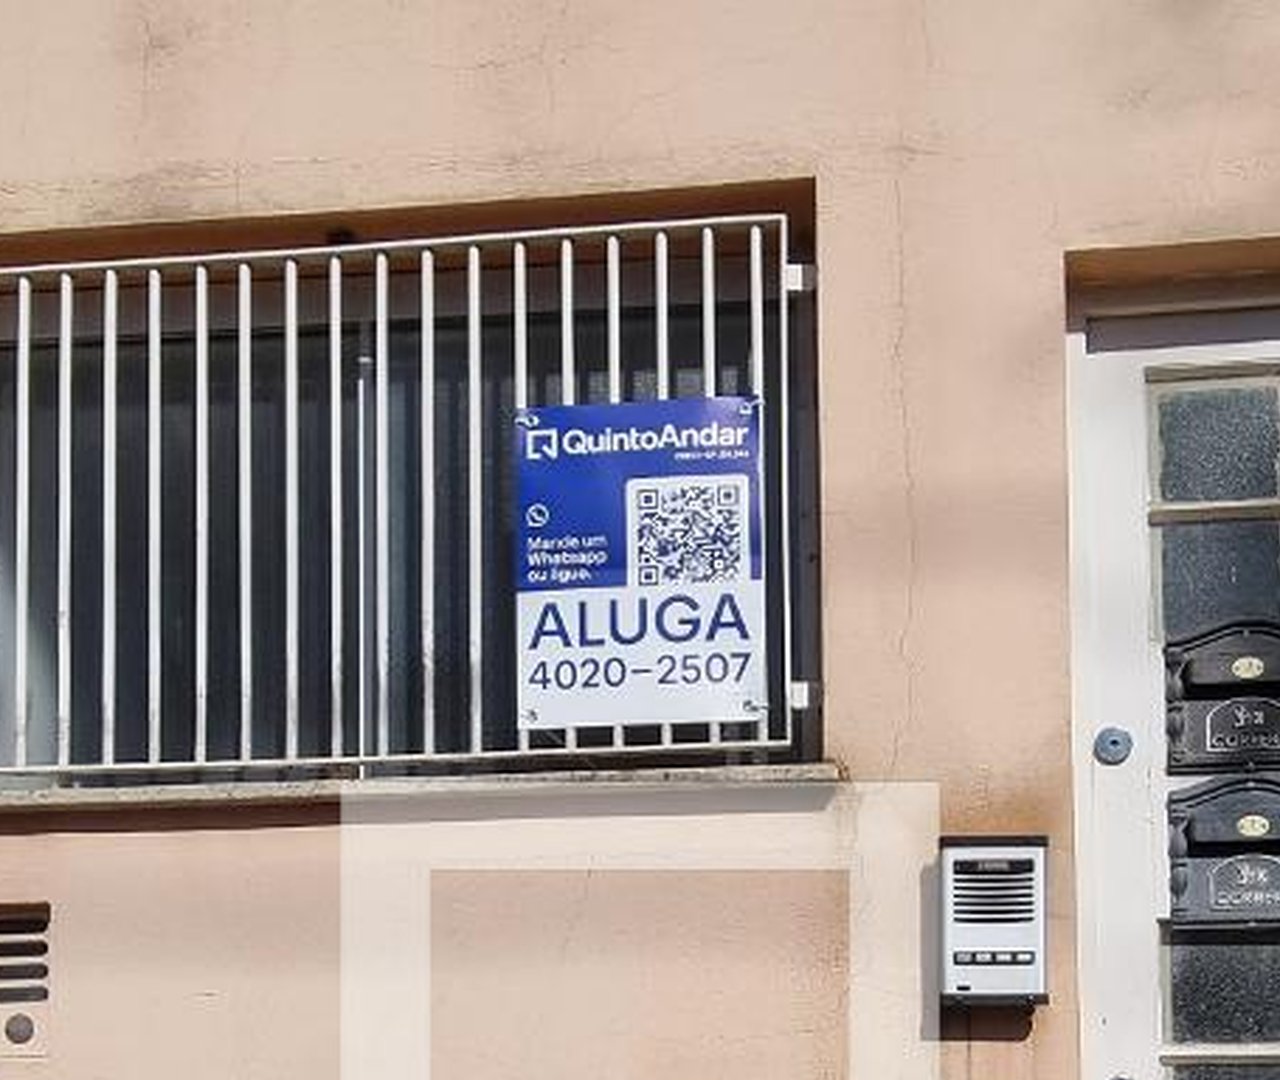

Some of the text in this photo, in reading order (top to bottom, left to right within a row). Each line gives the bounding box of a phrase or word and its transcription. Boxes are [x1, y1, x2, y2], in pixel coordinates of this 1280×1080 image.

[562, 422, 750, 456] QuintoAndar
[582, 534, 608, 548] um
[528, 593, 750, 650] ALUGA
[528, 653, 751, 690] 4020-2507
